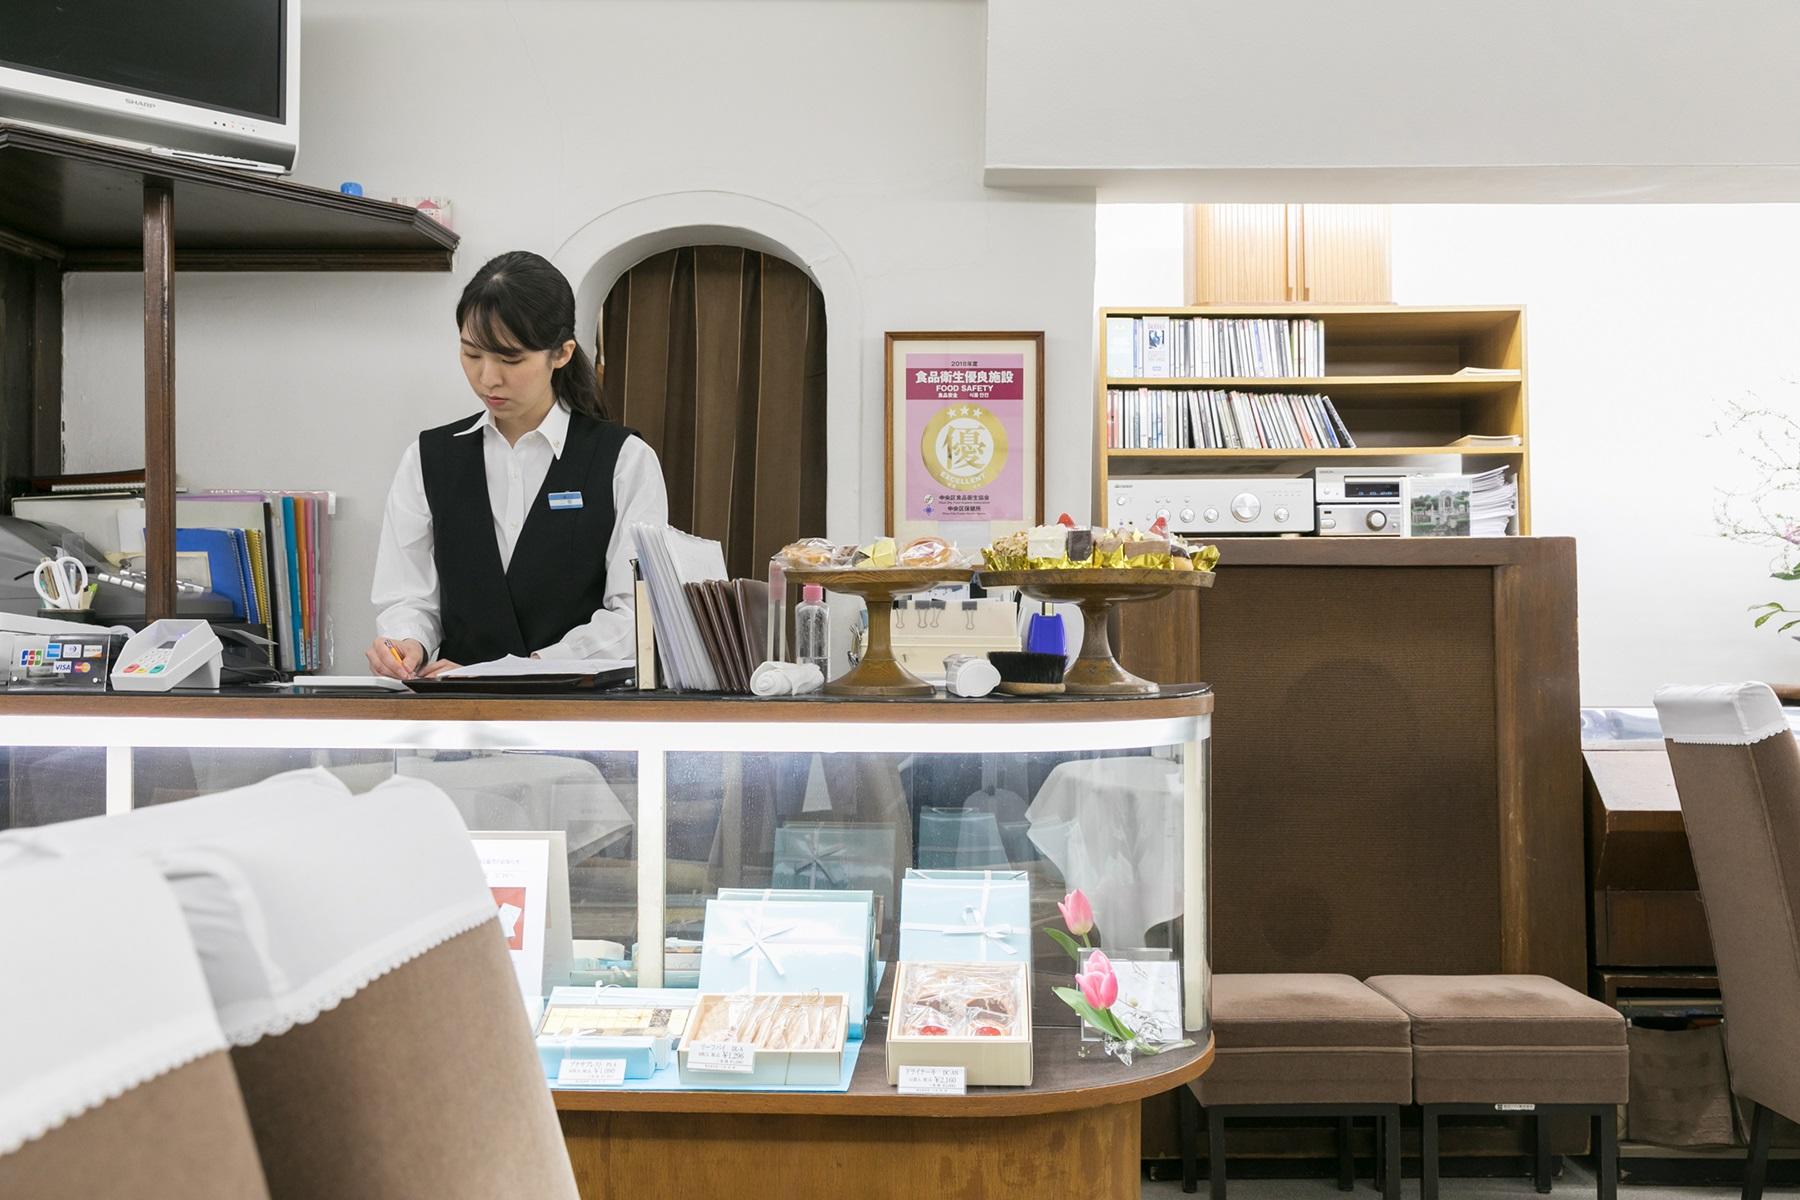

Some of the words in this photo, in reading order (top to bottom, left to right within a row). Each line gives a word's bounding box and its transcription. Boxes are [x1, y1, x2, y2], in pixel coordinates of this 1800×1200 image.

[915, 370, 1014, 384] 食品衛生優良施設
[936, 384, 960, 392] FOOD
[961, 384, 994, 392] SAFETY
[943, 425, 987, 470] 優
